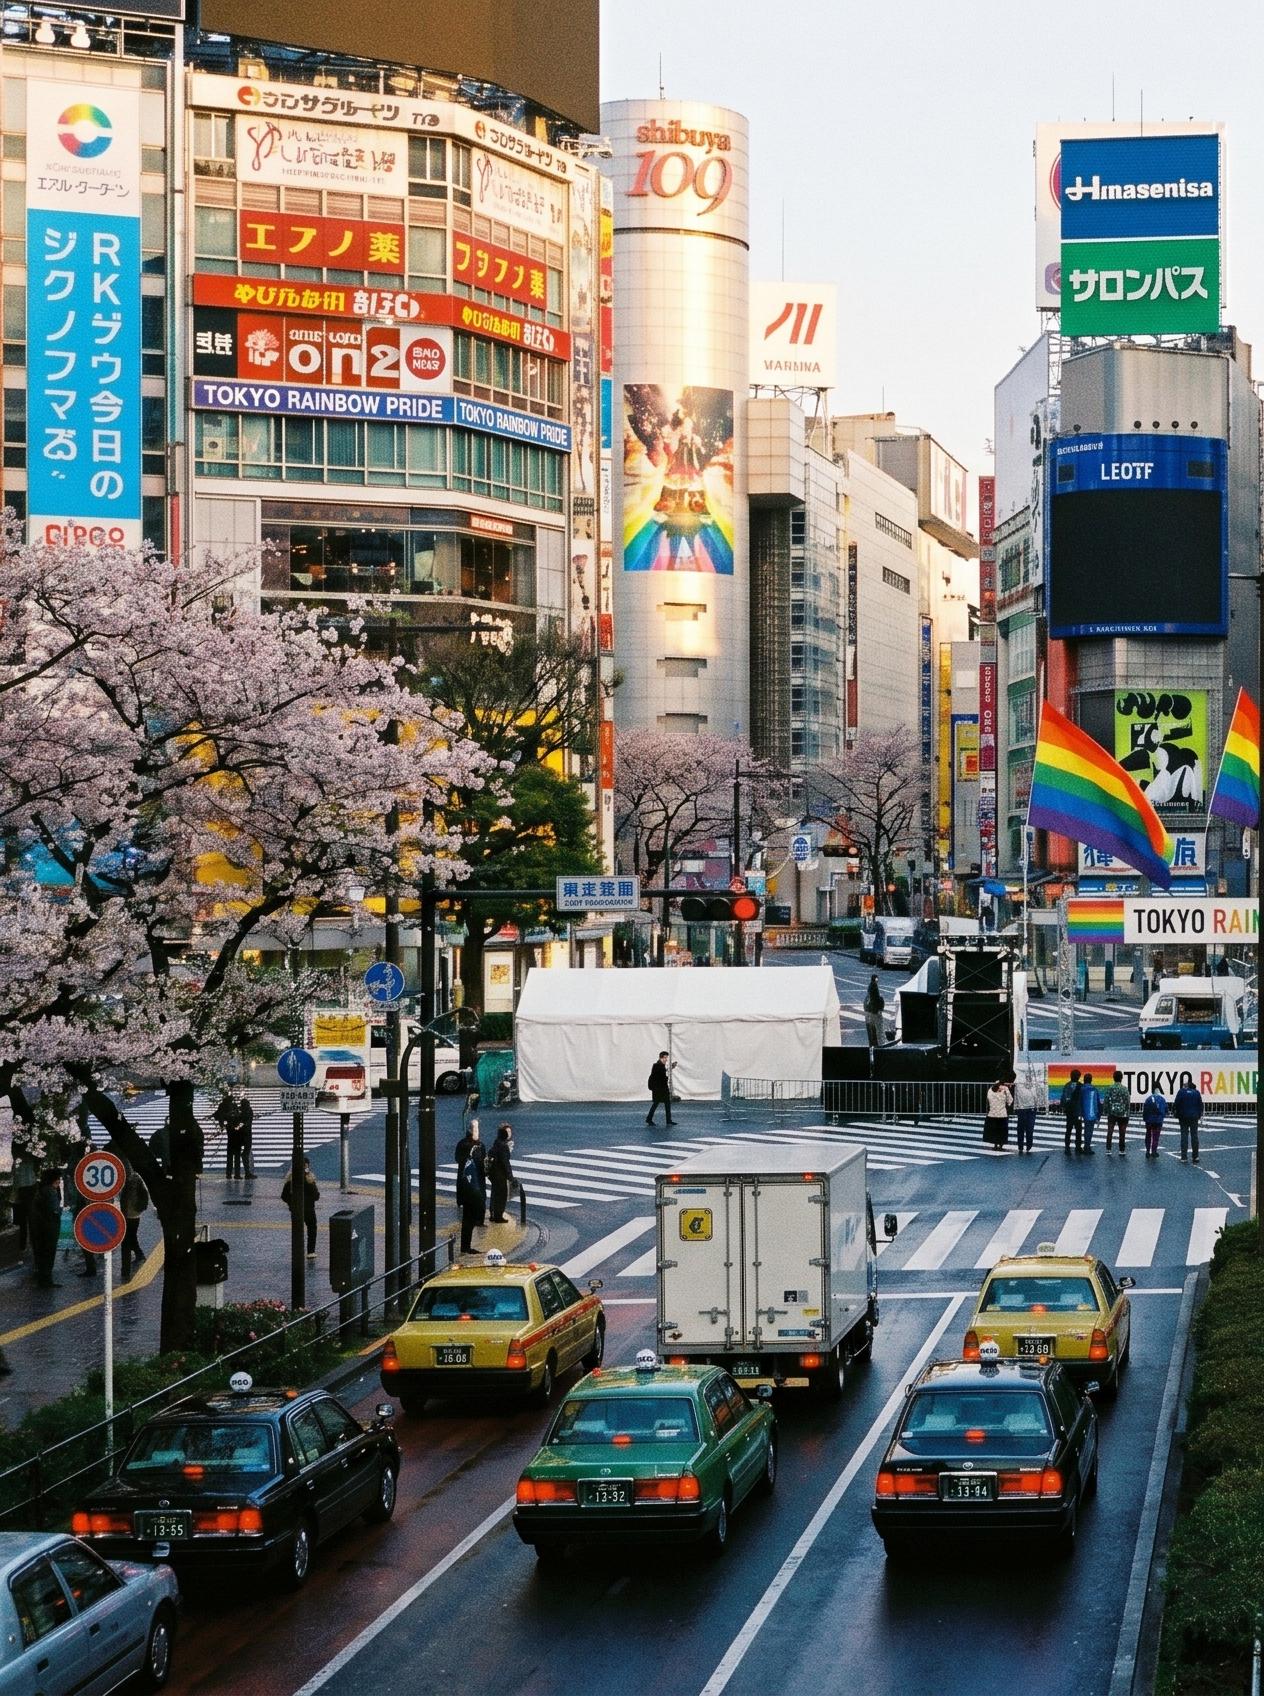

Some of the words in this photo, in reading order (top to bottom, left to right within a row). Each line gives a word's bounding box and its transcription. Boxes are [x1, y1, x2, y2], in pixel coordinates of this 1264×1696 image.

[637, 119, 731, 154] shibuya
[625, 150, 732, 216] 109
[1069, 266, 1209, 302] サロンパス
[203, 384, 281, 408] TOKYO
[288, 390, 380, 414] RAINBOW
[386, 396, 443, 418] PRIDE
[459, 402, 494, 427] TOKYO
[497, 411, 539, 438] RAINBOW
[541, 423, 568, 446] PRIDE
[1133, 909, 1205, 934] TOKYO
[1123, 1071, 1193, 1095] TOKYO
[86, 1165, 115, 1188] 30
